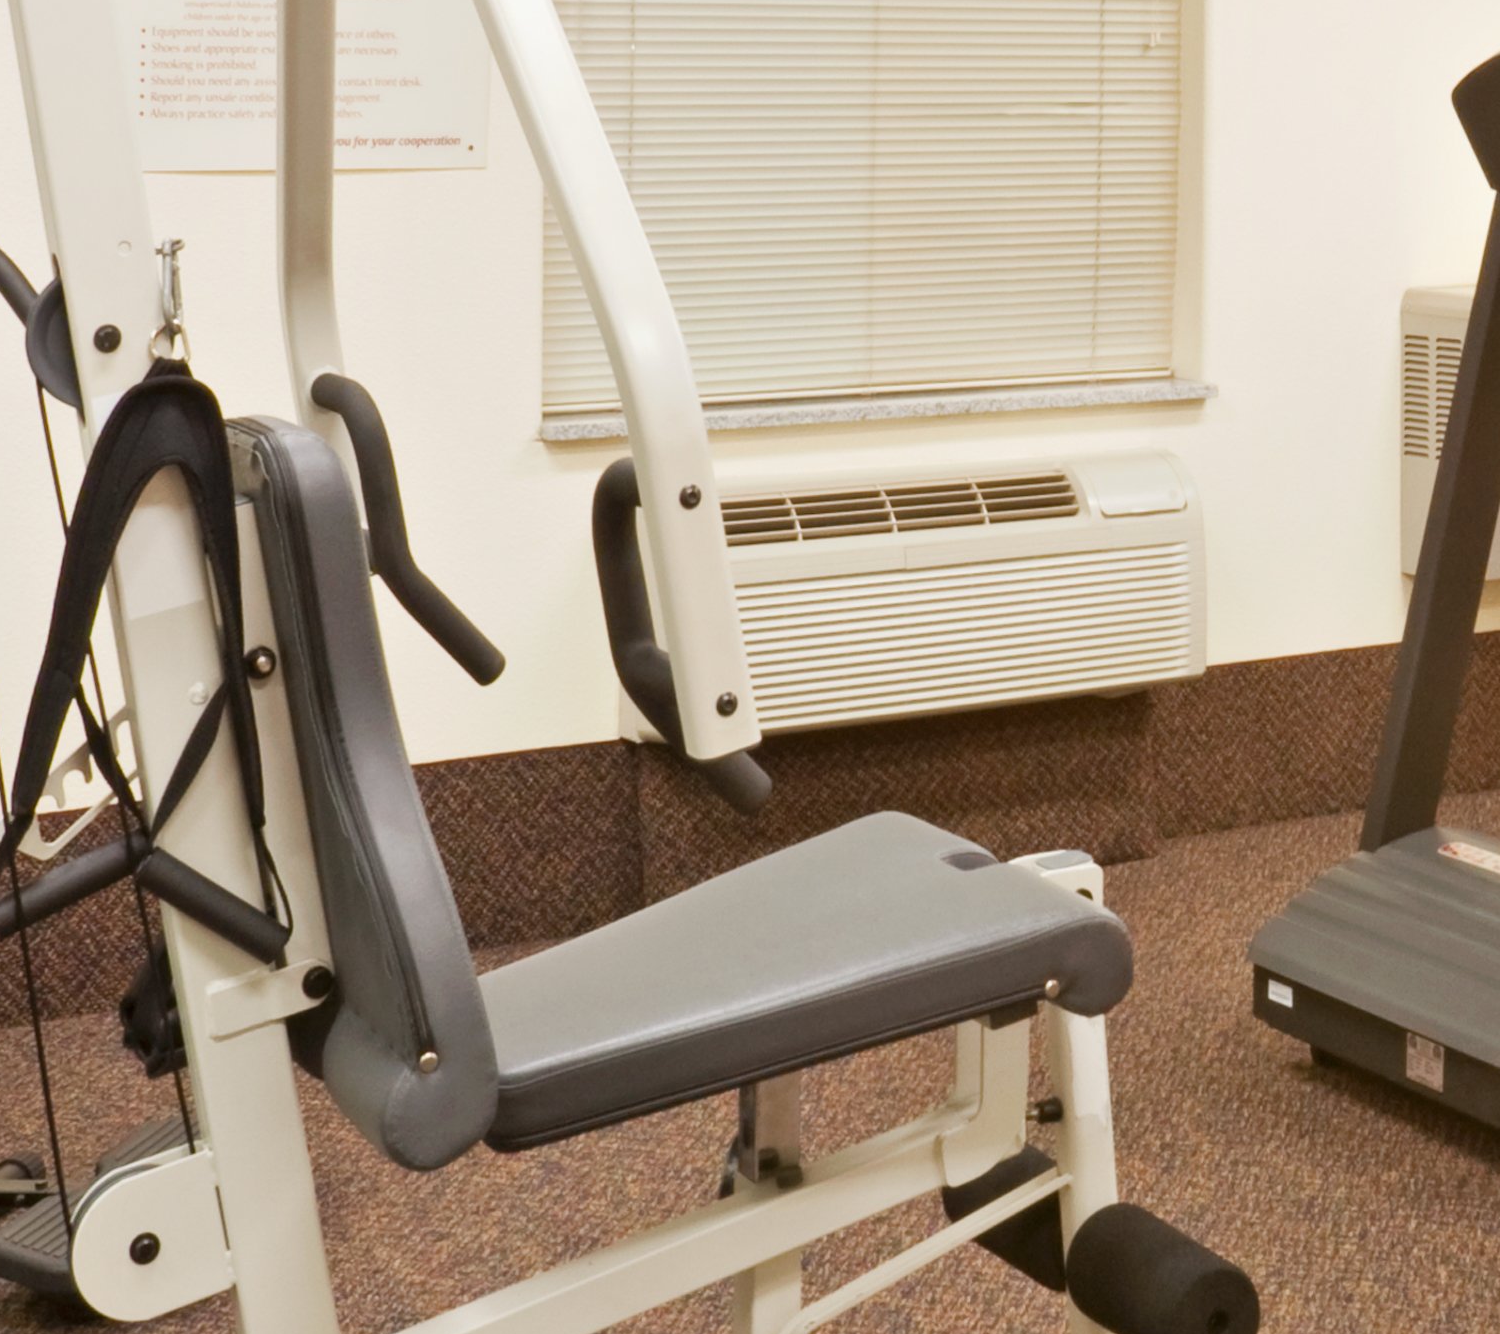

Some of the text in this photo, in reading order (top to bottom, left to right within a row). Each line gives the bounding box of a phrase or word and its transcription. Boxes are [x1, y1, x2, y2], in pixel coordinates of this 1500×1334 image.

[352, 137, 369, 149] for
[372, 138, 396, 149] your
[398, 136, 462, 149] cooperation
